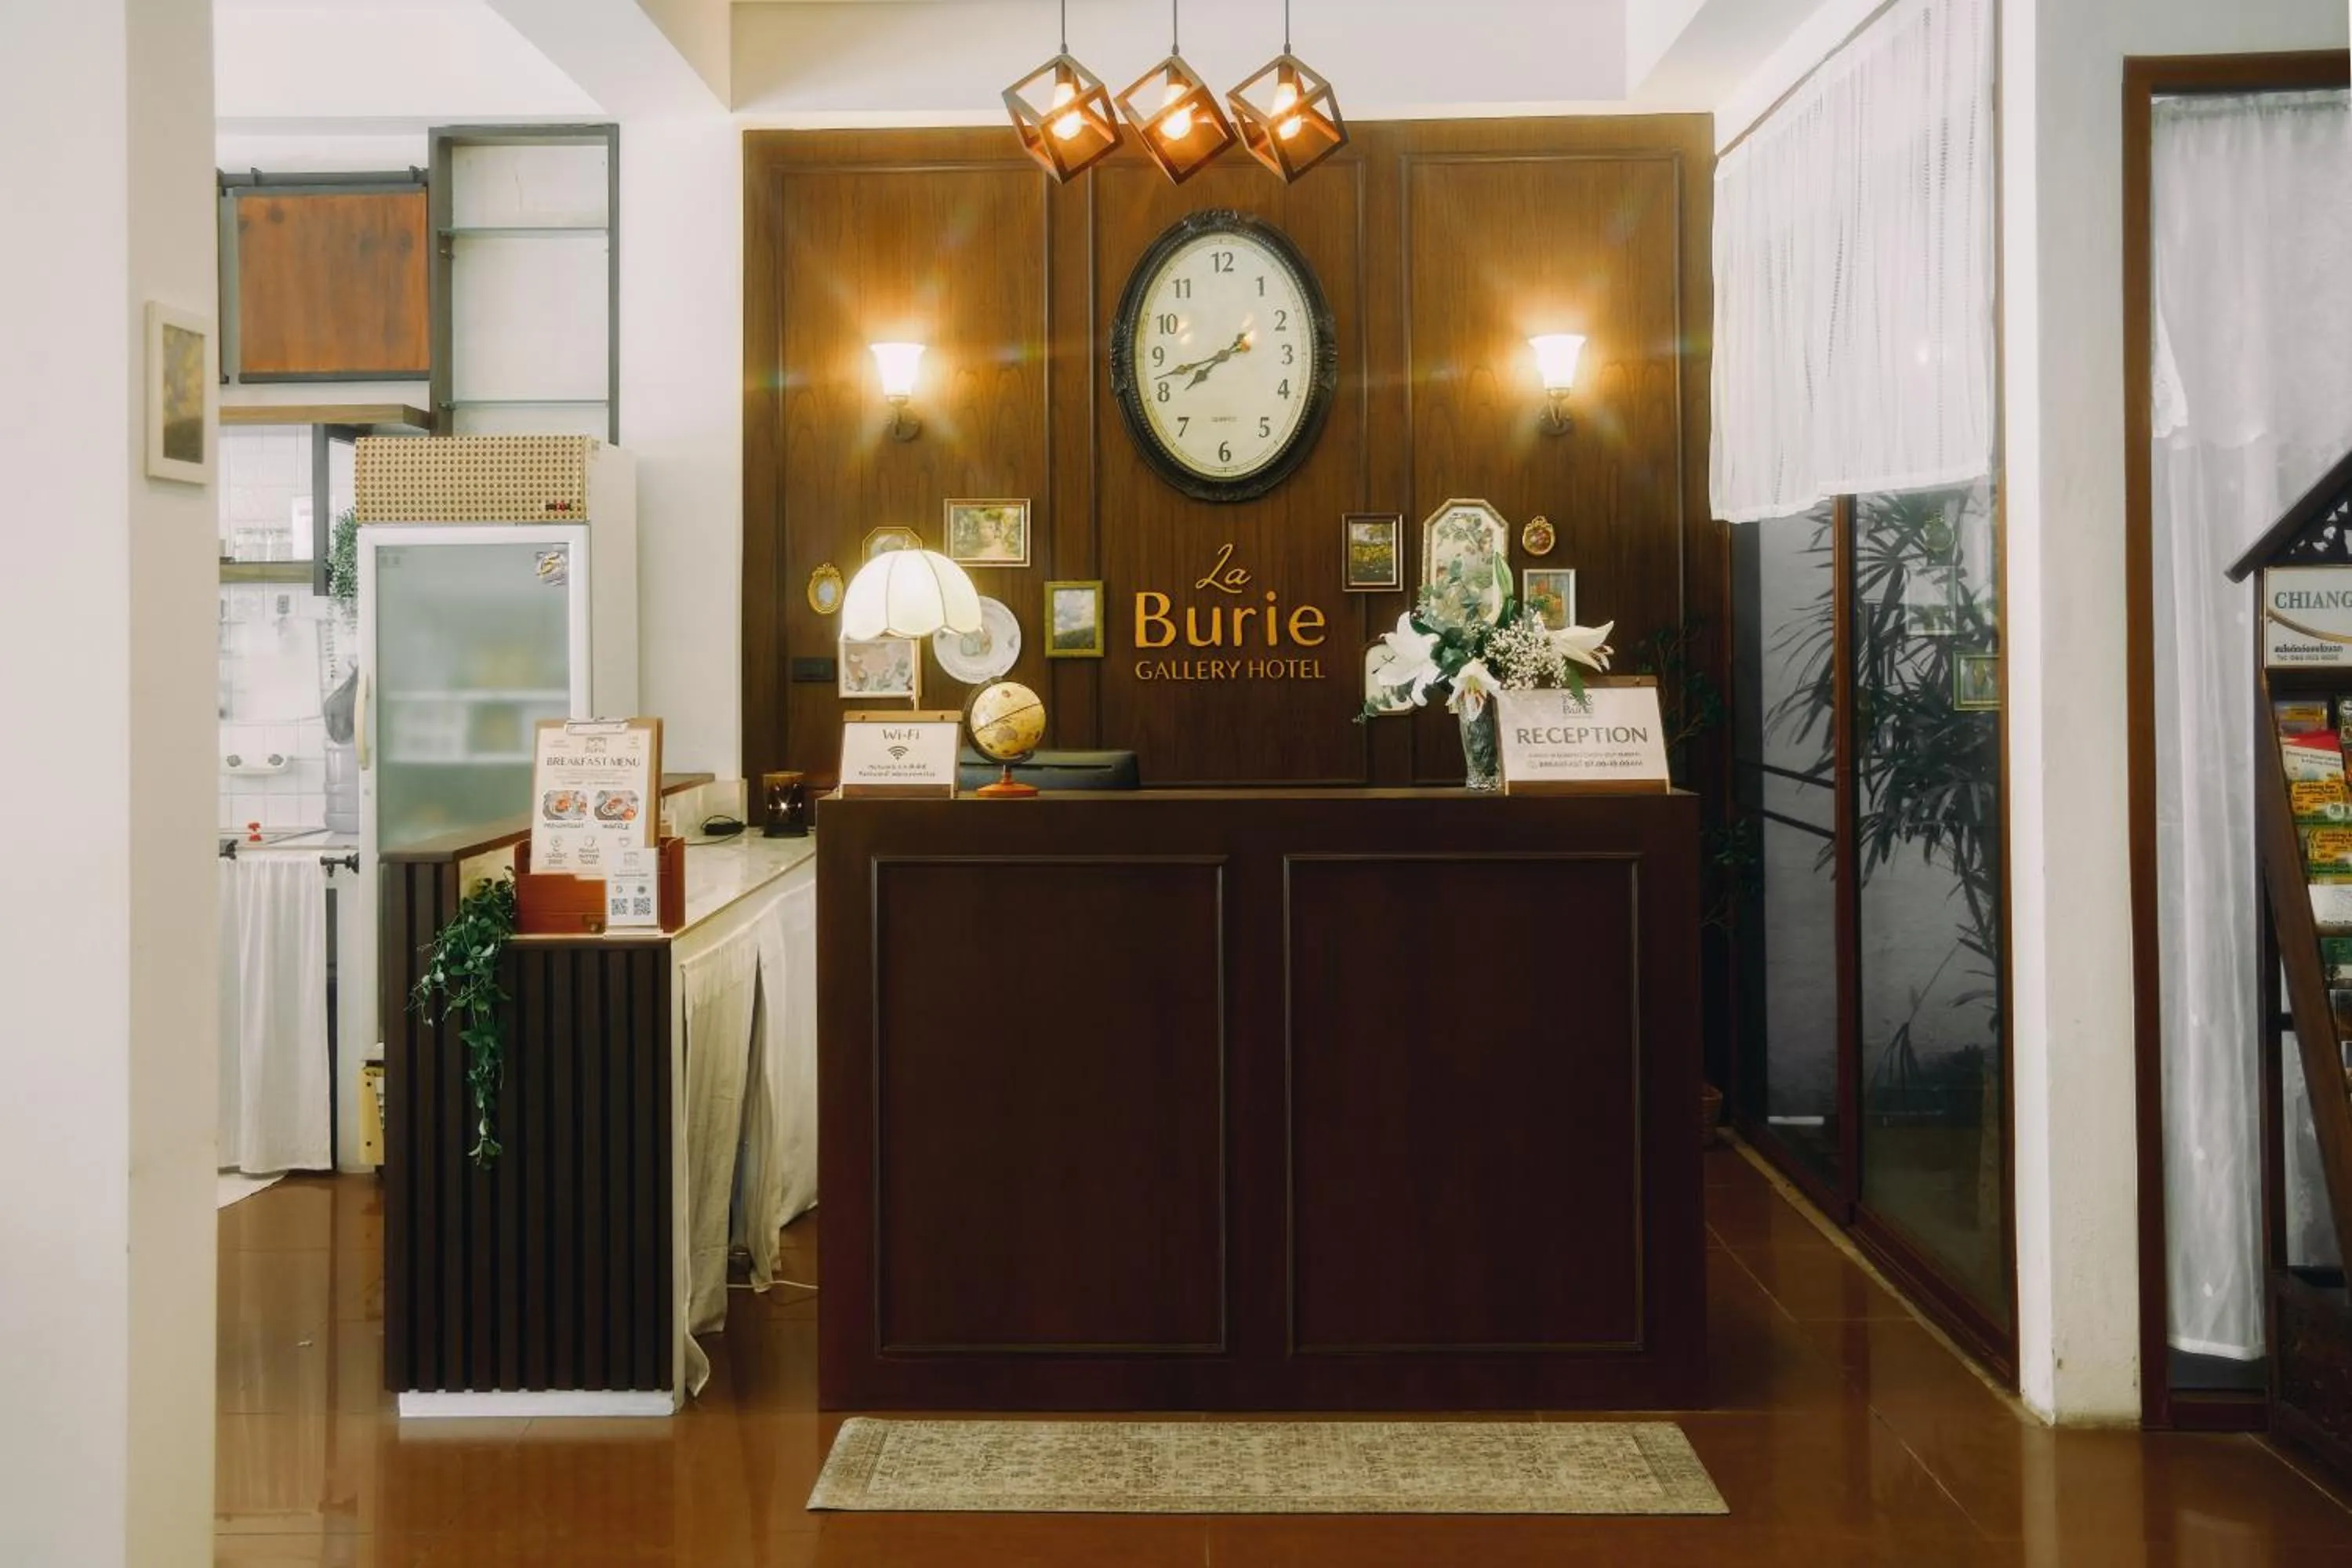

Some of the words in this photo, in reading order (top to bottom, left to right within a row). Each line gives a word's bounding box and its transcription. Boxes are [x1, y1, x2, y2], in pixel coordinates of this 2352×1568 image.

[1211, 252, 1234, 273] 12
[1173, 278, 1192, 299] 11
[1255, 276, 1265, 296] 1
[1156, 314, 1178, 335] 10
[1274, 310, 1287, 331] 2
[1152, 347, 1165, 367] 9
[1281, 344, 1294, 365] 3
[1156, 382, 1171, 402] 8
[1277, 379, 1290, 399] 4
[1177, 416, 1190, 438] 7
[1258, 416, 1271, 438] 5
[1218, 441, 1232, 463] 6
[1195, 543, 1252, 593] La
[2274, 591, 2352, 608] CHIANG
[1134, 590, 1327, 648] Burie
[1135, 660, 1241, 680] GALLERY
[1249, 659, 1326, 678] HOTEL
[1516, 727, 1649, 744] RECEPTION
[546, 757, 608, 766] BREAKFAST
[610, 757, 641, 767] MENU
